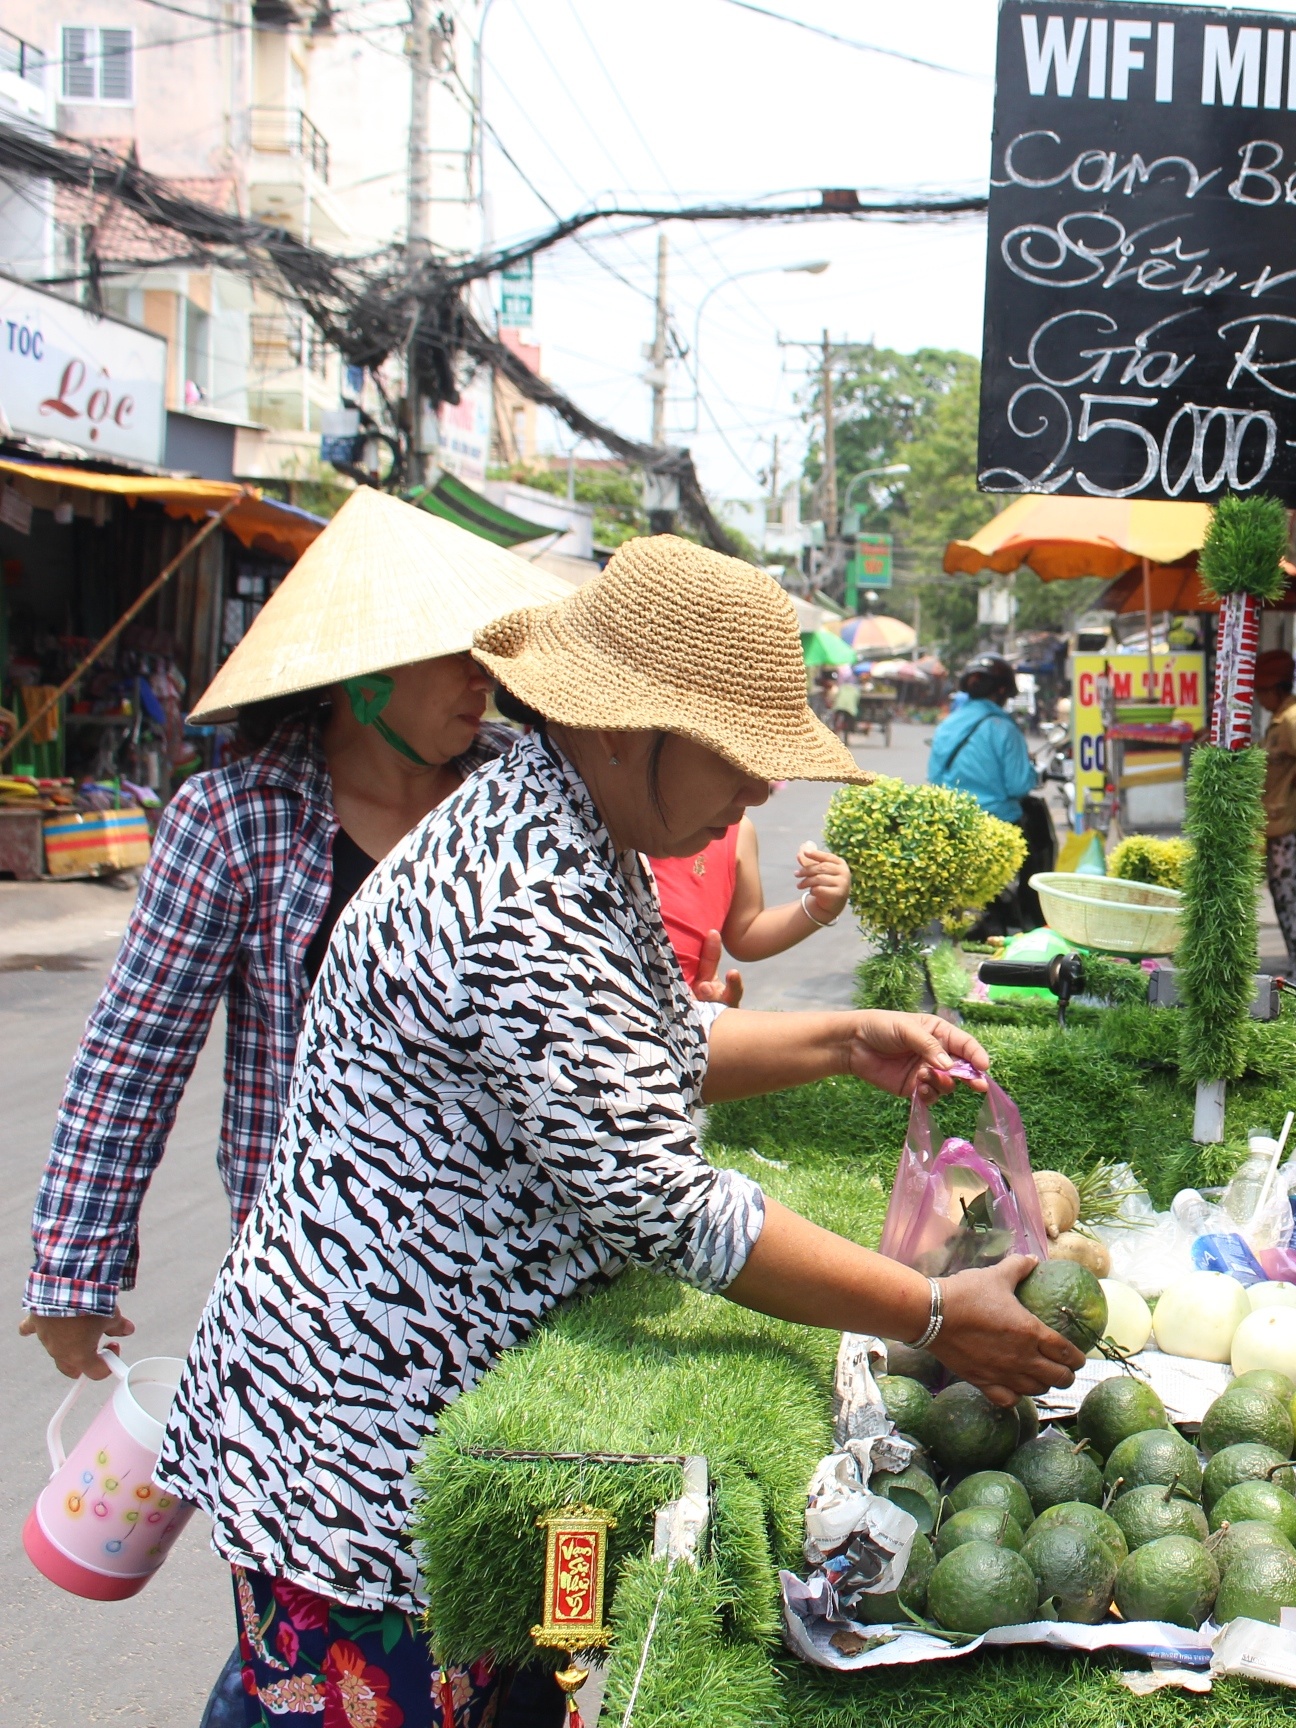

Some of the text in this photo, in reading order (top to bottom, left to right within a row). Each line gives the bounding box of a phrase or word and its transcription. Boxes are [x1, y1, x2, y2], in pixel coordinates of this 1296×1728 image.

[1020, 14, 1175, 103] WIFI
[991, 130, 1222, 198] Cam
[1008, 306, 1204, 388] Giá
[37, 357, 135, 442] Lộc
[977, 382, 1278, 499] 25000
